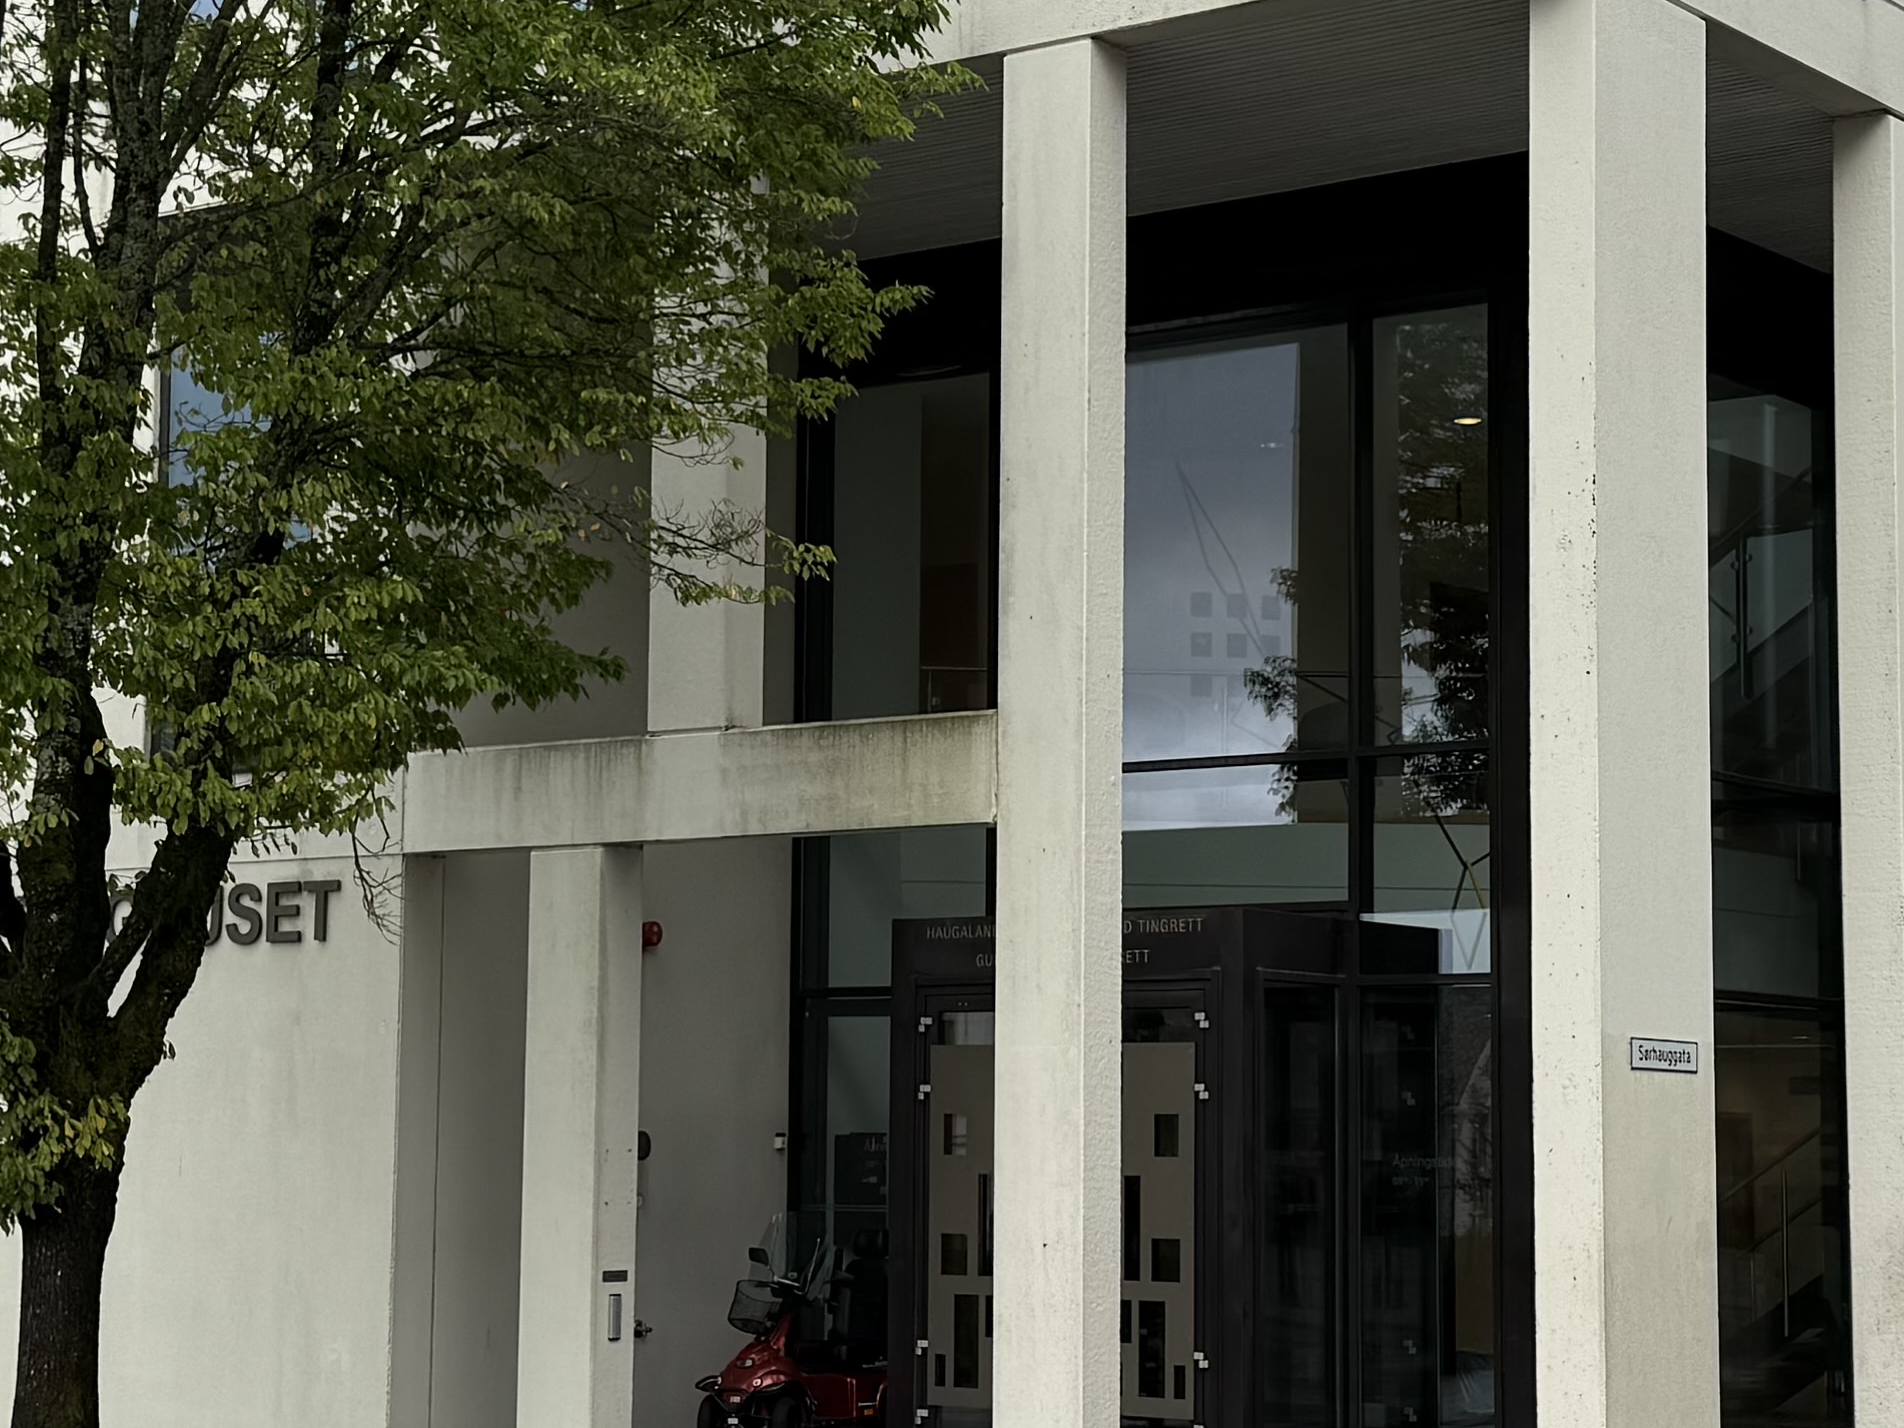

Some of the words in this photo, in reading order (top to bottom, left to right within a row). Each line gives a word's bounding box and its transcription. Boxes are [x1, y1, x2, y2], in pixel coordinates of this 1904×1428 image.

[926, 924, 996, 940] HAUGALAN
[1137, 918, 1204, 933] TINGRETT
[1638, 1044, 1691, 1067] Sørhauggata
